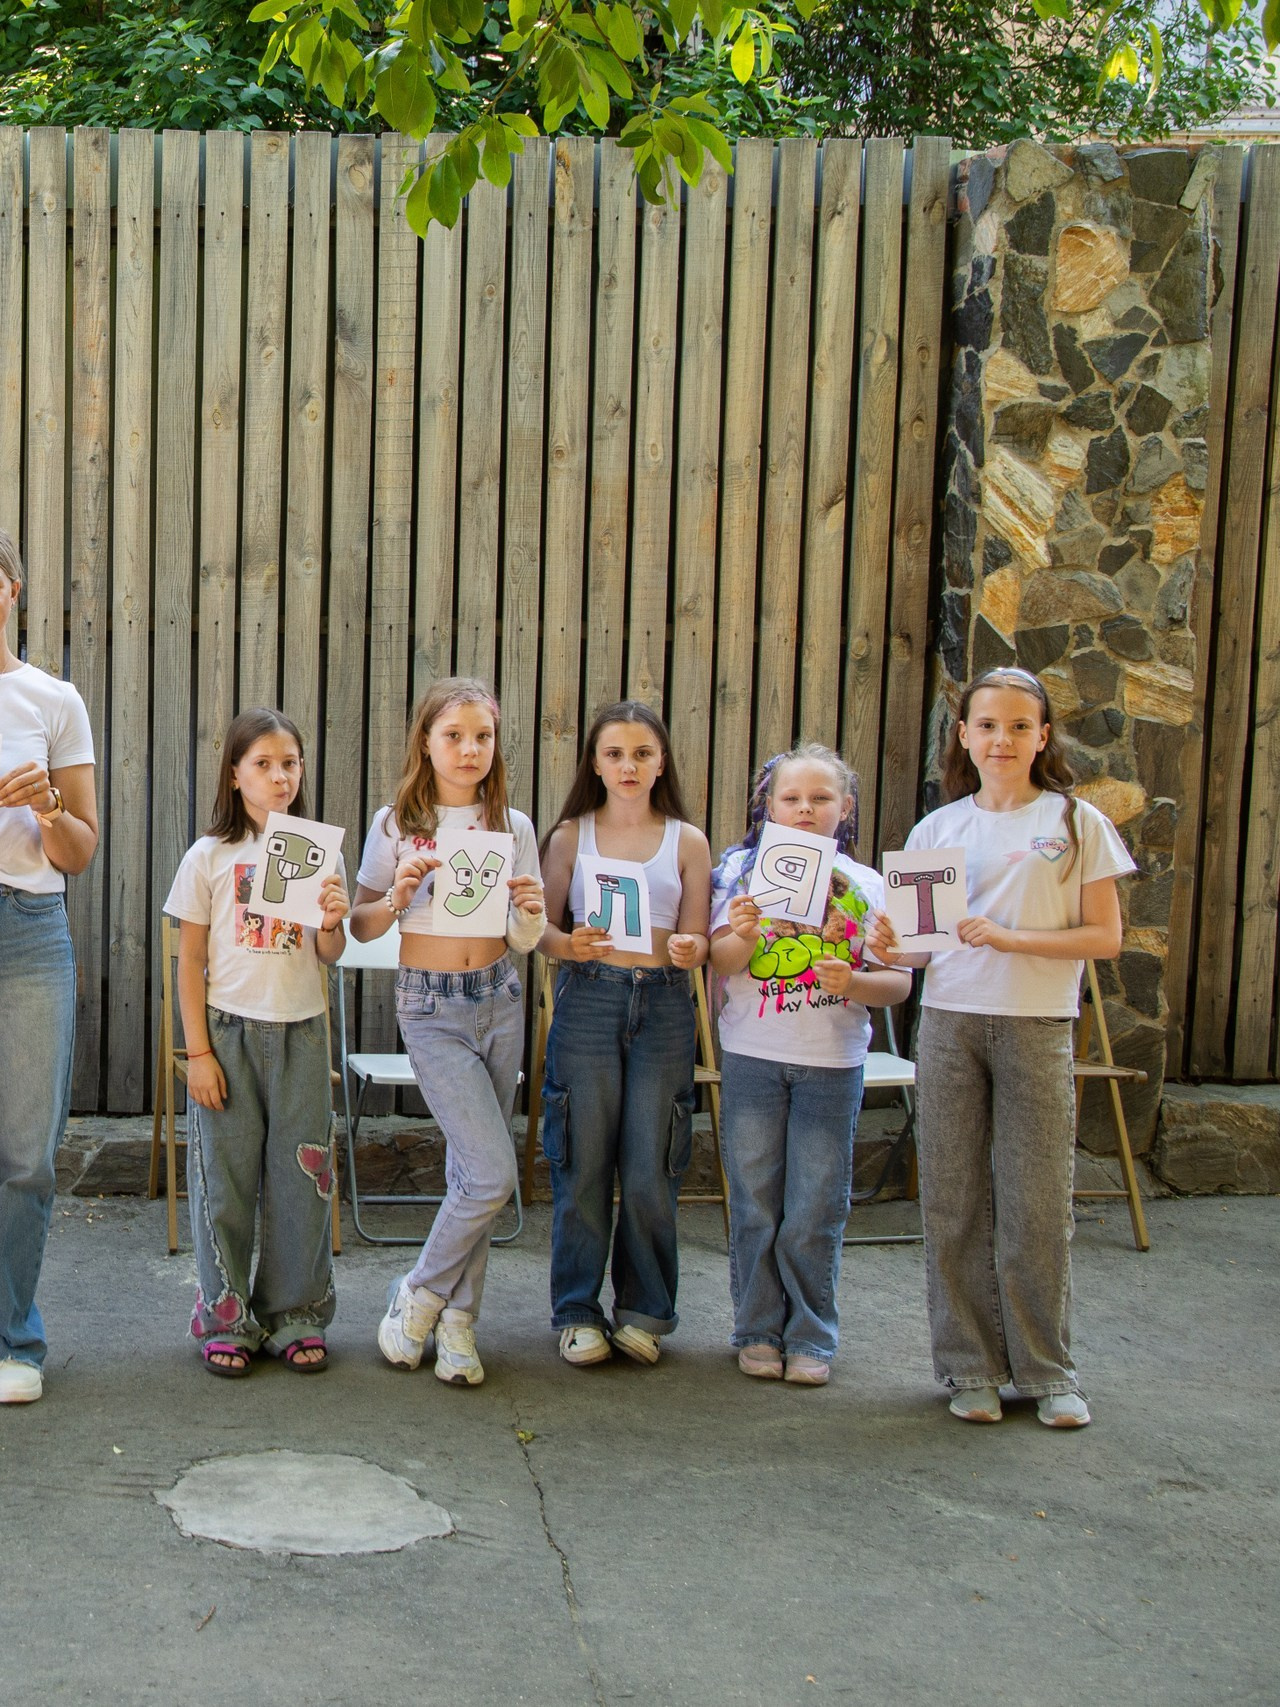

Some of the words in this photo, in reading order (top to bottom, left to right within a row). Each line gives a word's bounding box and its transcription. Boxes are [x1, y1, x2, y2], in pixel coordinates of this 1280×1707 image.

[751, 843, 822, 917] Я
[758, 978, 821, 998] WELCOM
[778, 1000, 802, 1013] MY
